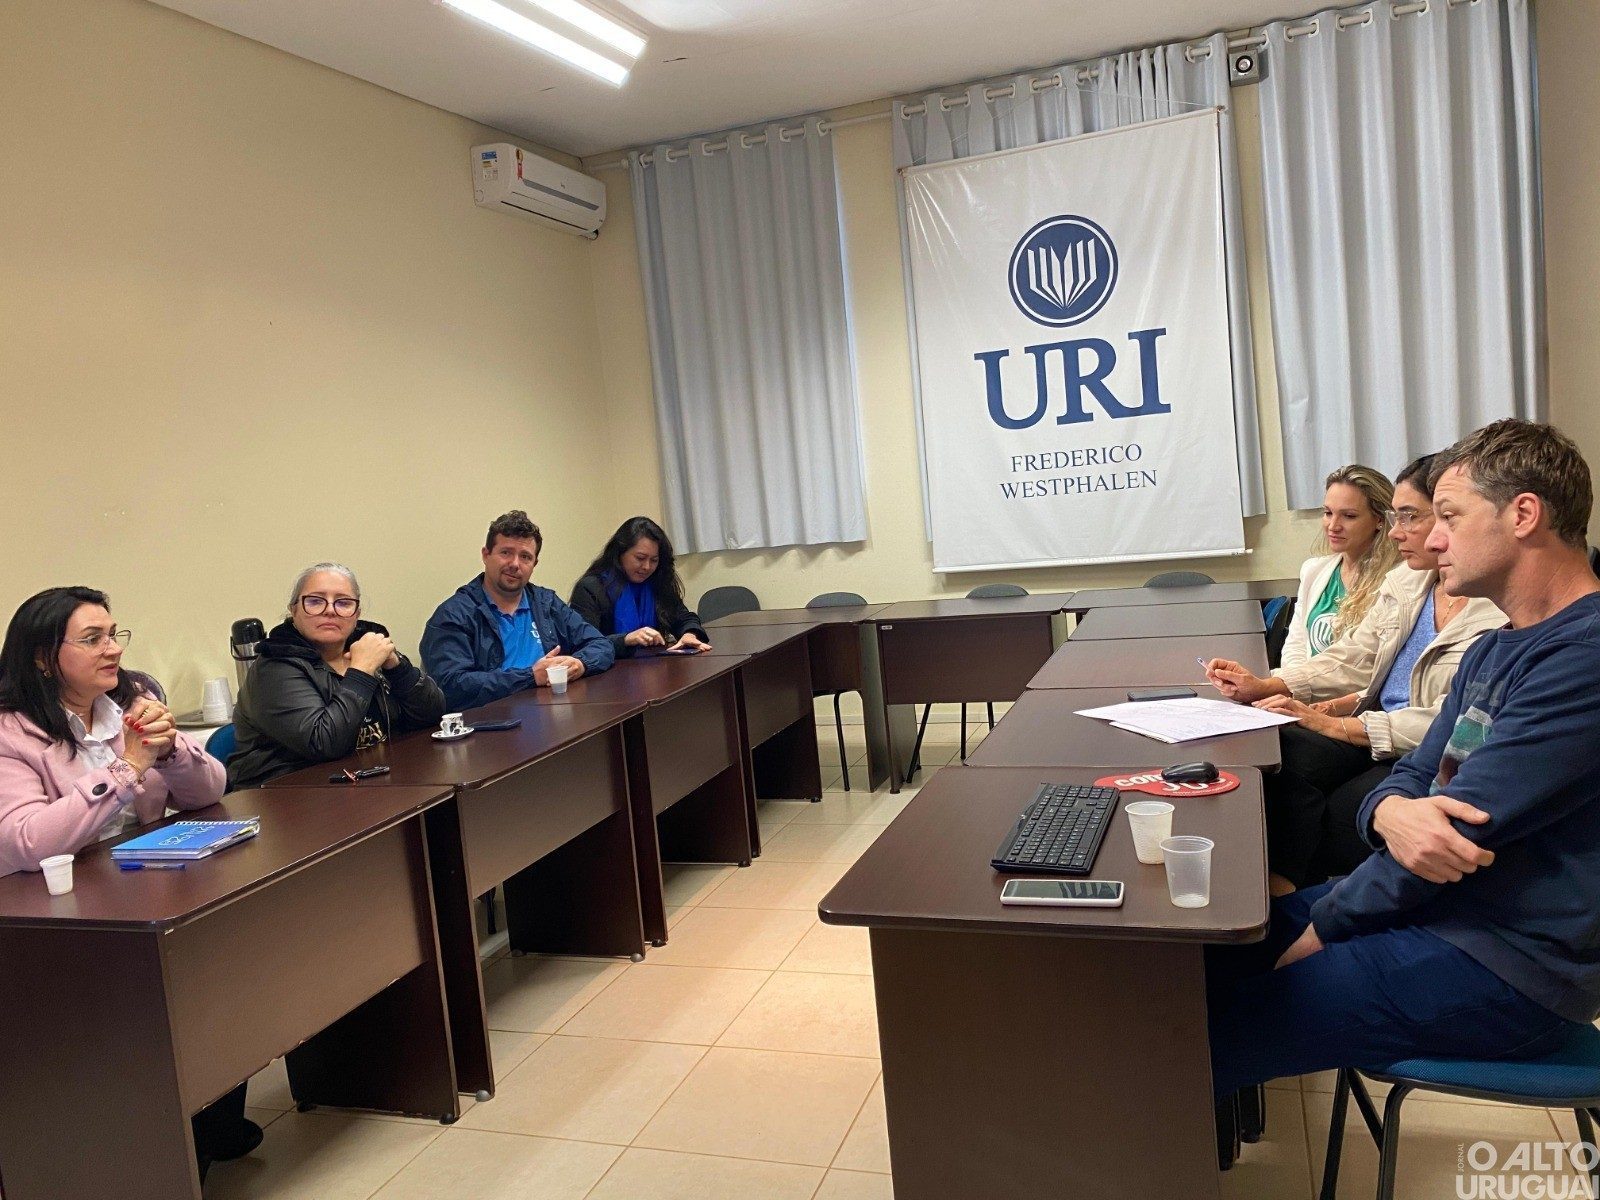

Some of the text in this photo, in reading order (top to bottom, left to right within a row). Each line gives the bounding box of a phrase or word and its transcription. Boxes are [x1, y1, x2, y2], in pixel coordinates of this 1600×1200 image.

[974, 328, 1171, 430] URI
[1011, 443, 1143, 473] FREDERICO
[1000, 469, 1158, 500] WESTPHALEN
